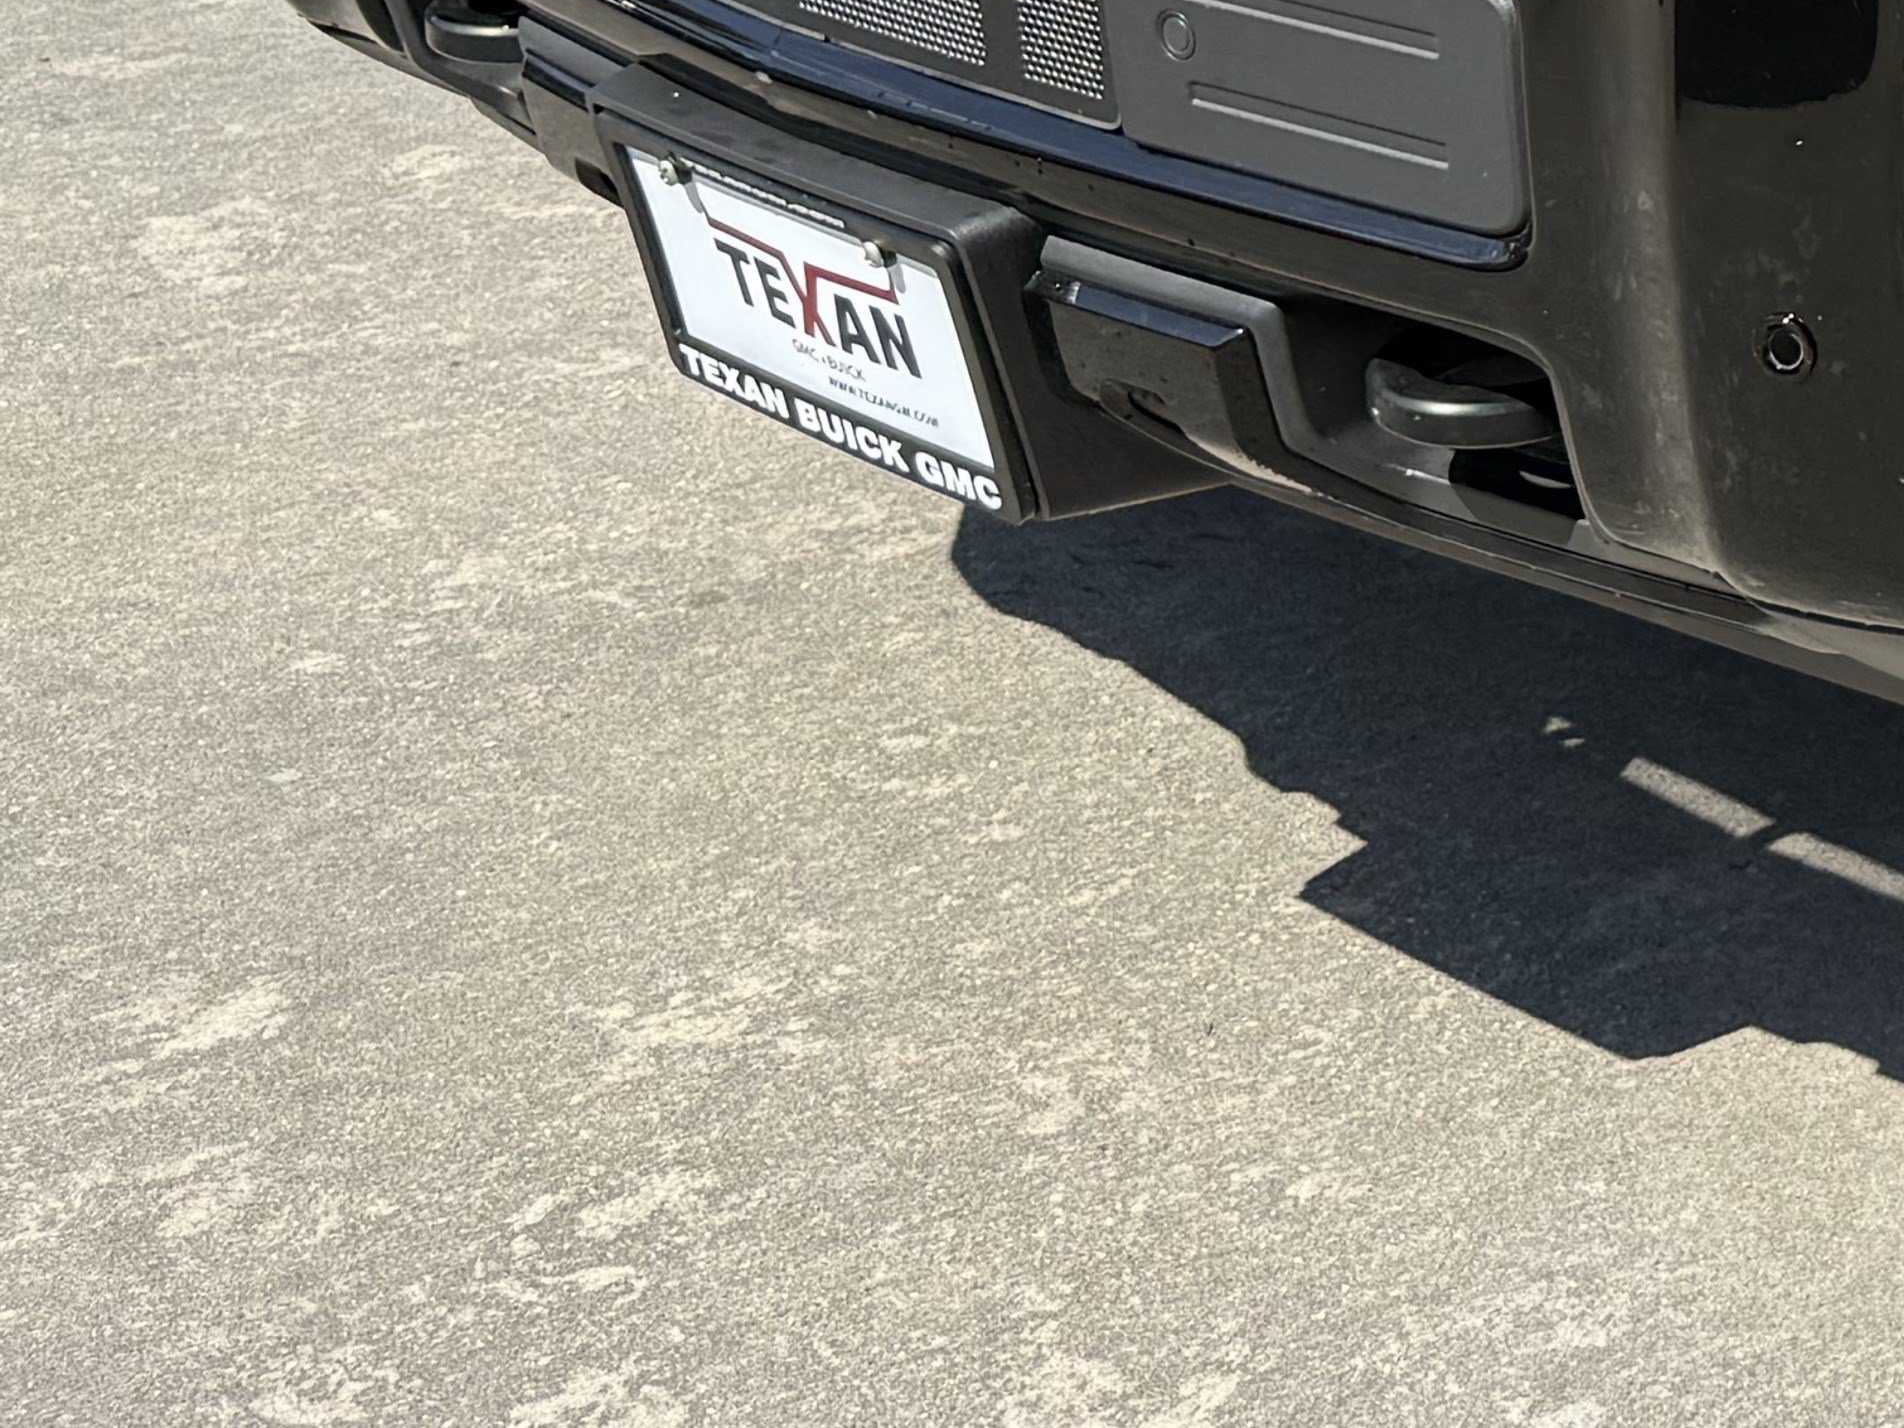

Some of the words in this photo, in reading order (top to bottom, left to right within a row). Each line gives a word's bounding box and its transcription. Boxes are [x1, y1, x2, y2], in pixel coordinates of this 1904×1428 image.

[713, 237, 922, 378] TEXAN
[679, 344, 790, 419] TEXAN
[794, 398, 910, 473] BUICK
[914, 450, 1002, 511] GMC
